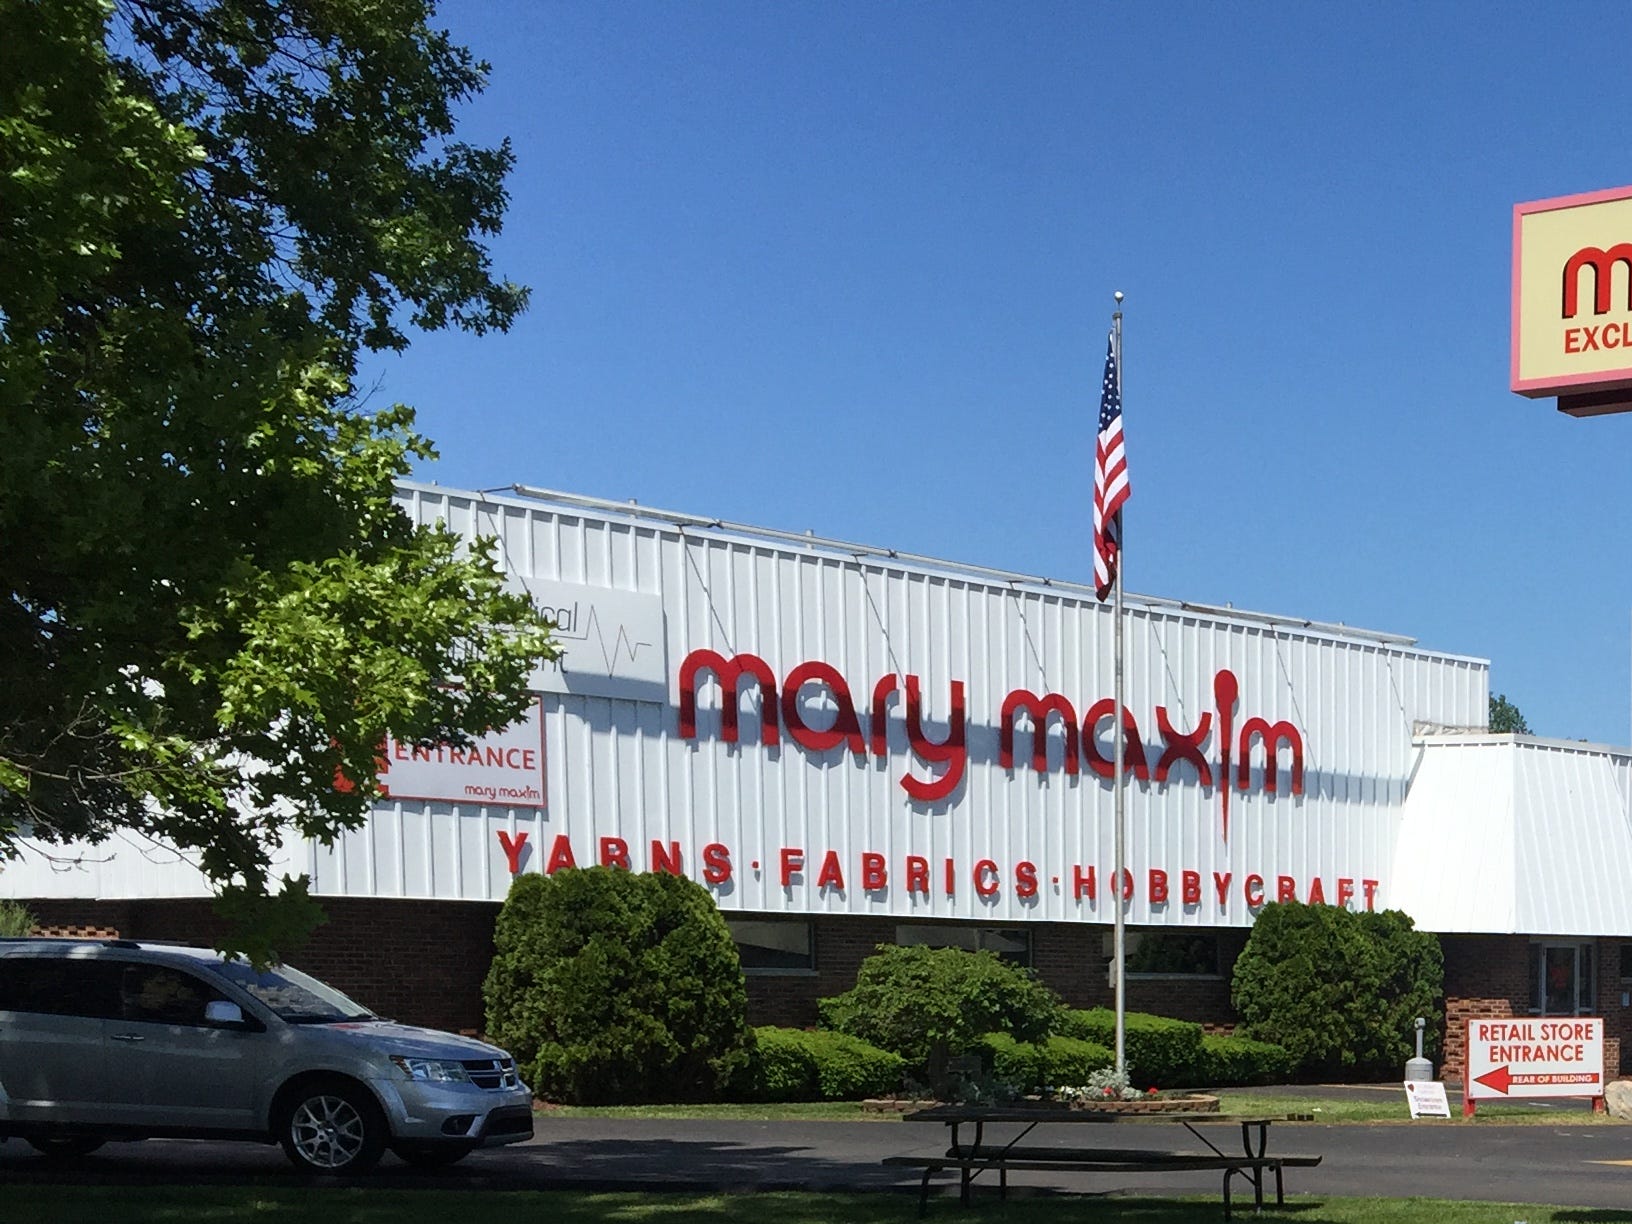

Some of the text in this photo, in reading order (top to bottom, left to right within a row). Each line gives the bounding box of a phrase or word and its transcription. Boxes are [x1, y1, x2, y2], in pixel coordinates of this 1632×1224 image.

[678, 648, 1304, 843] mary maxim
[464, 784, 540, 799] mary maxim
[497, 830, 733, 885] YARNS
[780, 848, 1038, 898] FABRICS
[1479, 1023, 1594, 1041] RETAIL STORE
[1489, 1044, 1584, 1062] ENTRANCE
[1512, 1074, 1593, 1084] REAR OF BUILDING
